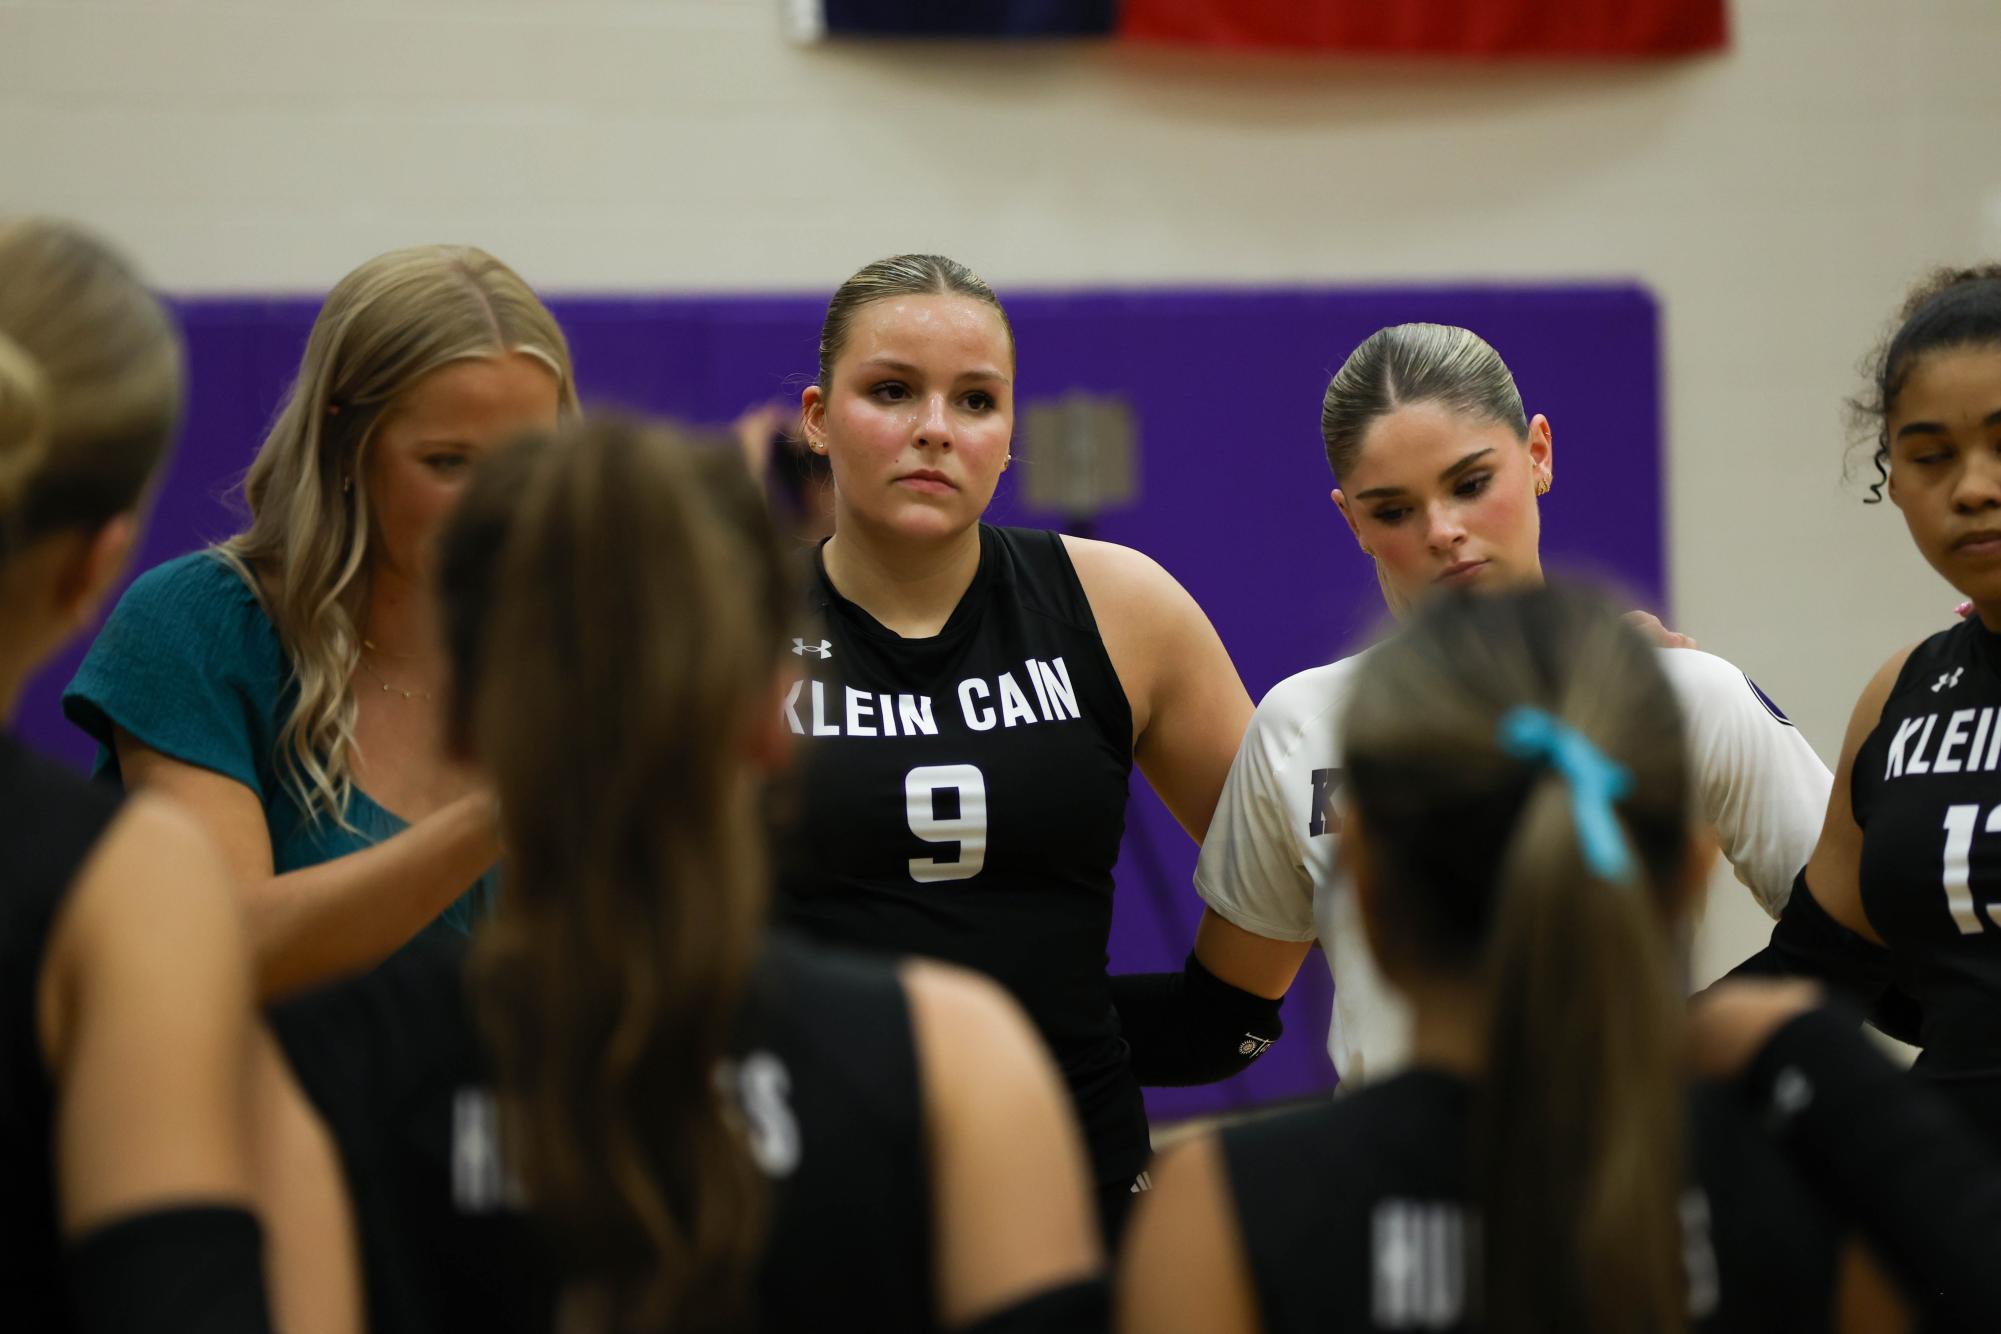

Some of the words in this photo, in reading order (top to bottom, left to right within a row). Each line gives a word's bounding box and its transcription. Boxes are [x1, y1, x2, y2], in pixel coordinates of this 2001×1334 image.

[778, 679, 939, 736] KLEIN
[957, 657, 1081, 731] CAIN
[905, 763, 987, 883] 9
[1943, 804, 2001, 934] 1
